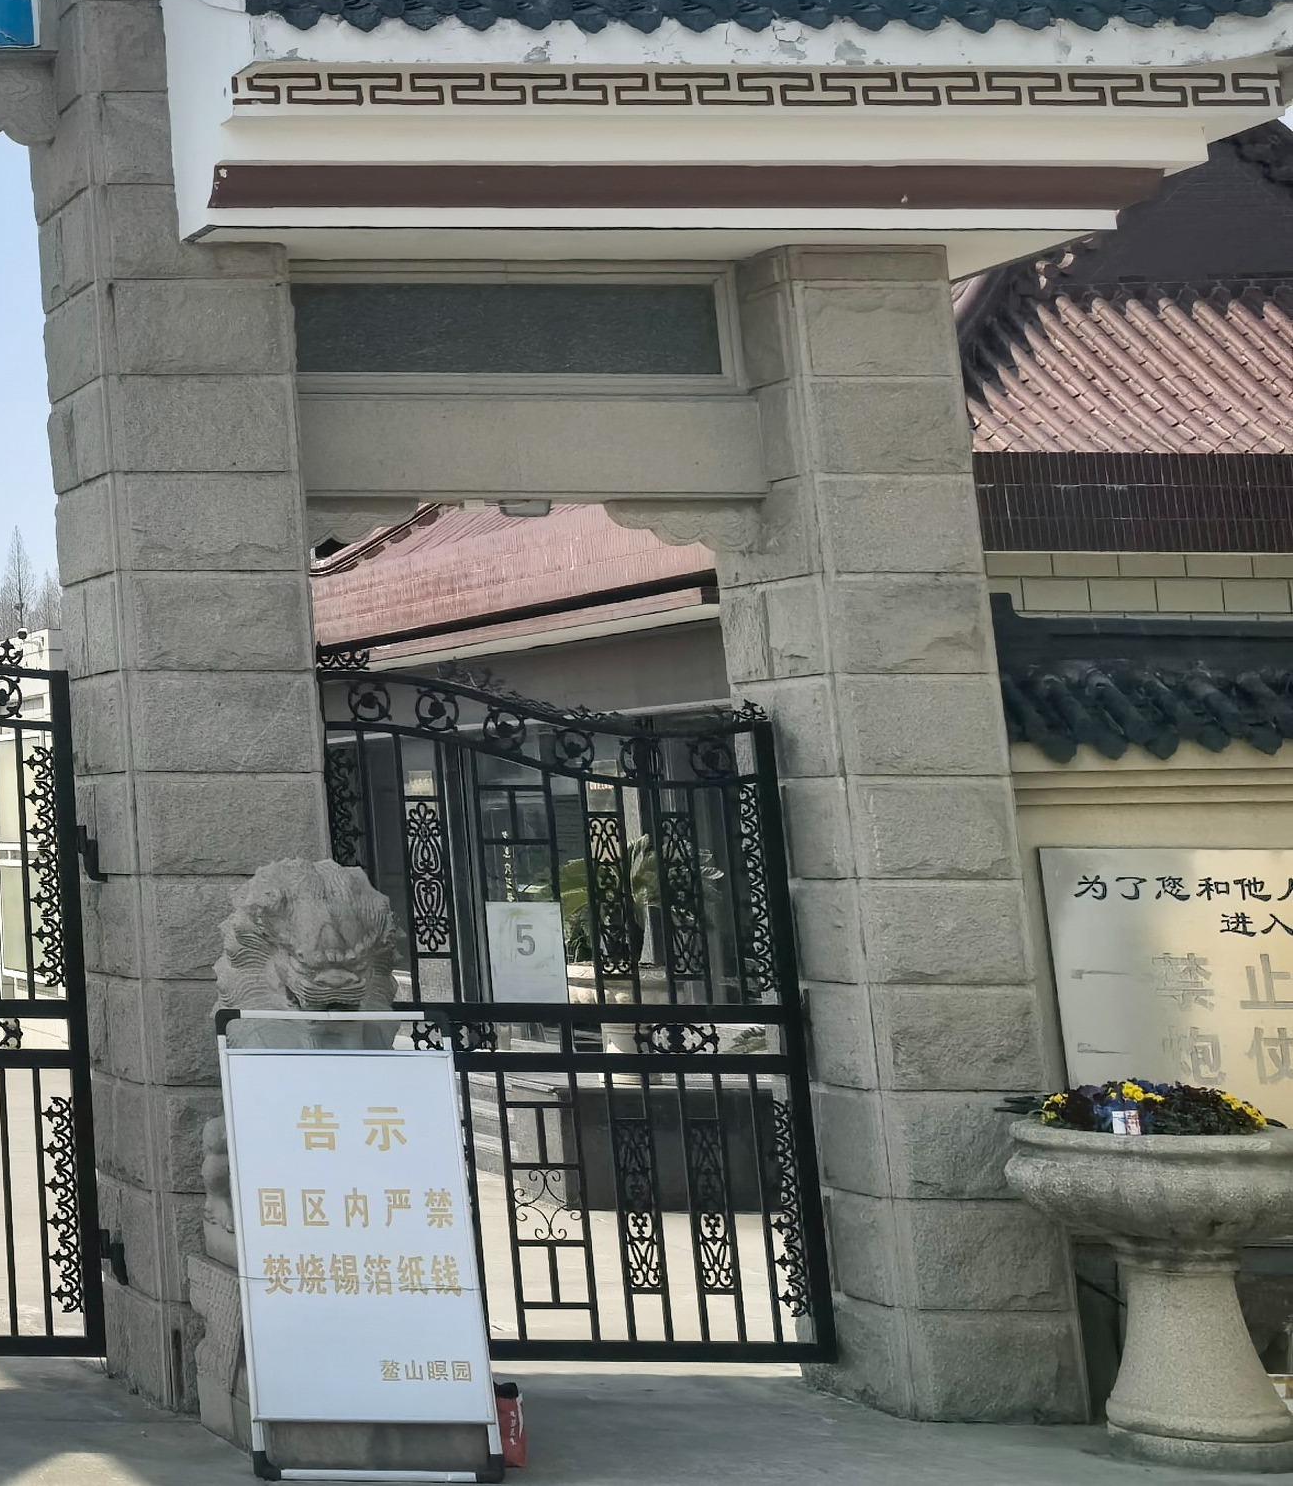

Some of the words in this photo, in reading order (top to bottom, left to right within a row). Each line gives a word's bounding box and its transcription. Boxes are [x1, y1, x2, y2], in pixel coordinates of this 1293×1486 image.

[516, 924, 536, 956] 5
[1219, 912, 1293, 938] 进入
[297, 1105, 407, 1151] 告示
[258, 1187, 454, 1228] 园区内严禁
[263, 1254, 462, 1297] 焚烧锡箔纸钱
